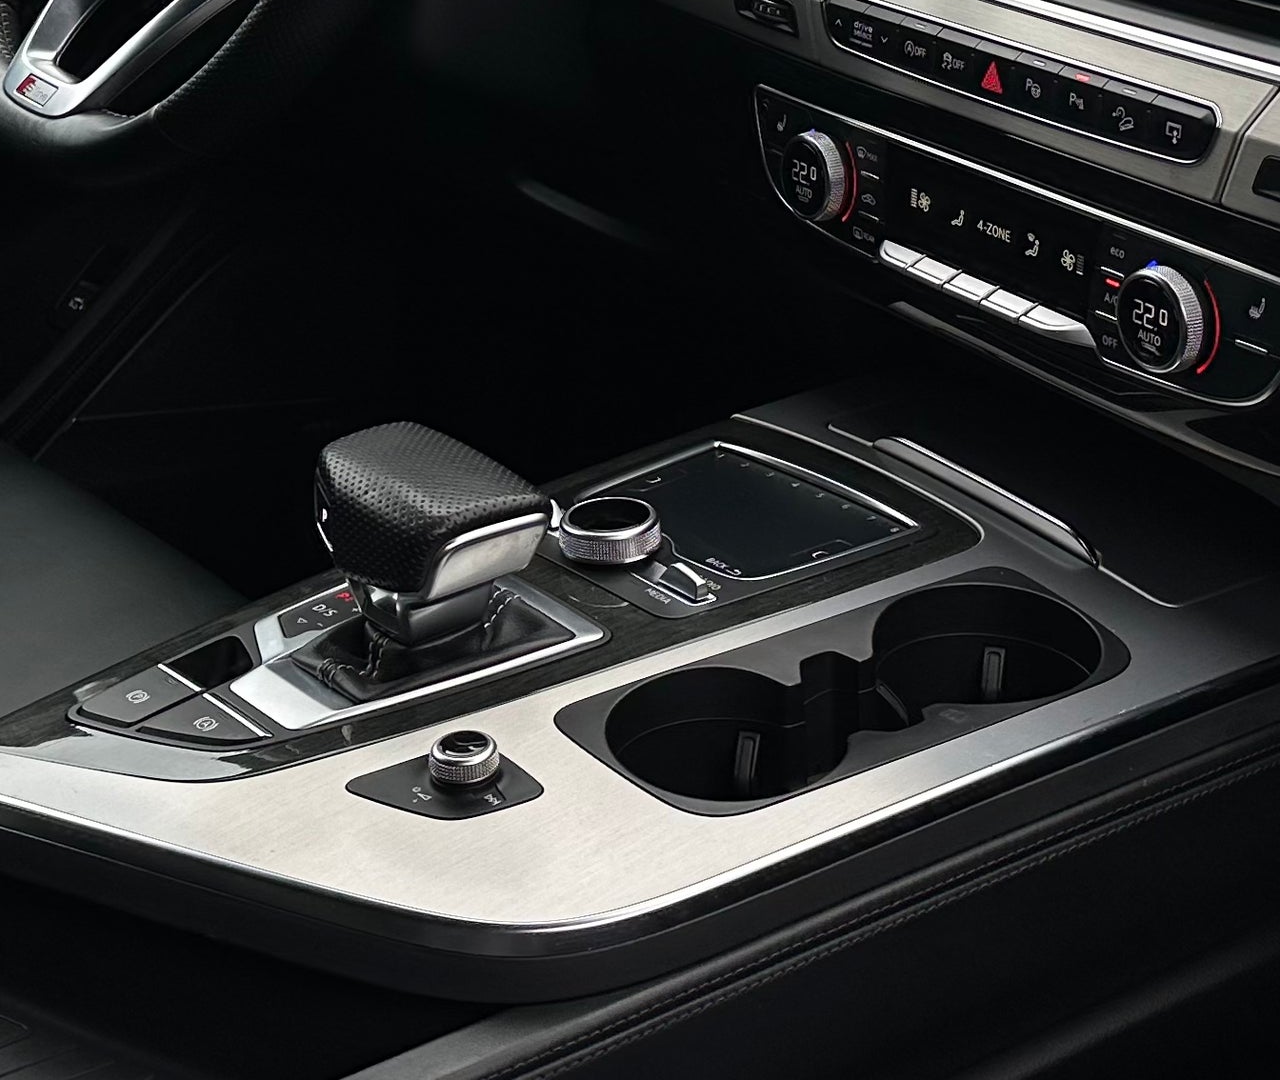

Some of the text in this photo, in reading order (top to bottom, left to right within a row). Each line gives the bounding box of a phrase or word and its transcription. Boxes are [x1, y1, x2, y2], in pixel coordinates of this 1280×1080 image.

[853, 21, 873, 32] drive
[915, 46, 927, 58] OFF
[952, 58, 965, 70] OFF
[976, 219, 1011, 243] 4-ZONE
[1110, 245, 1125, 259] eco
[1102, 335, 1118, 349] OFF
[1137, 329, 1161, 347] AUTO
[645, 587, 671, 605] MEDIA
[312, 603, 338, 617] D/S
